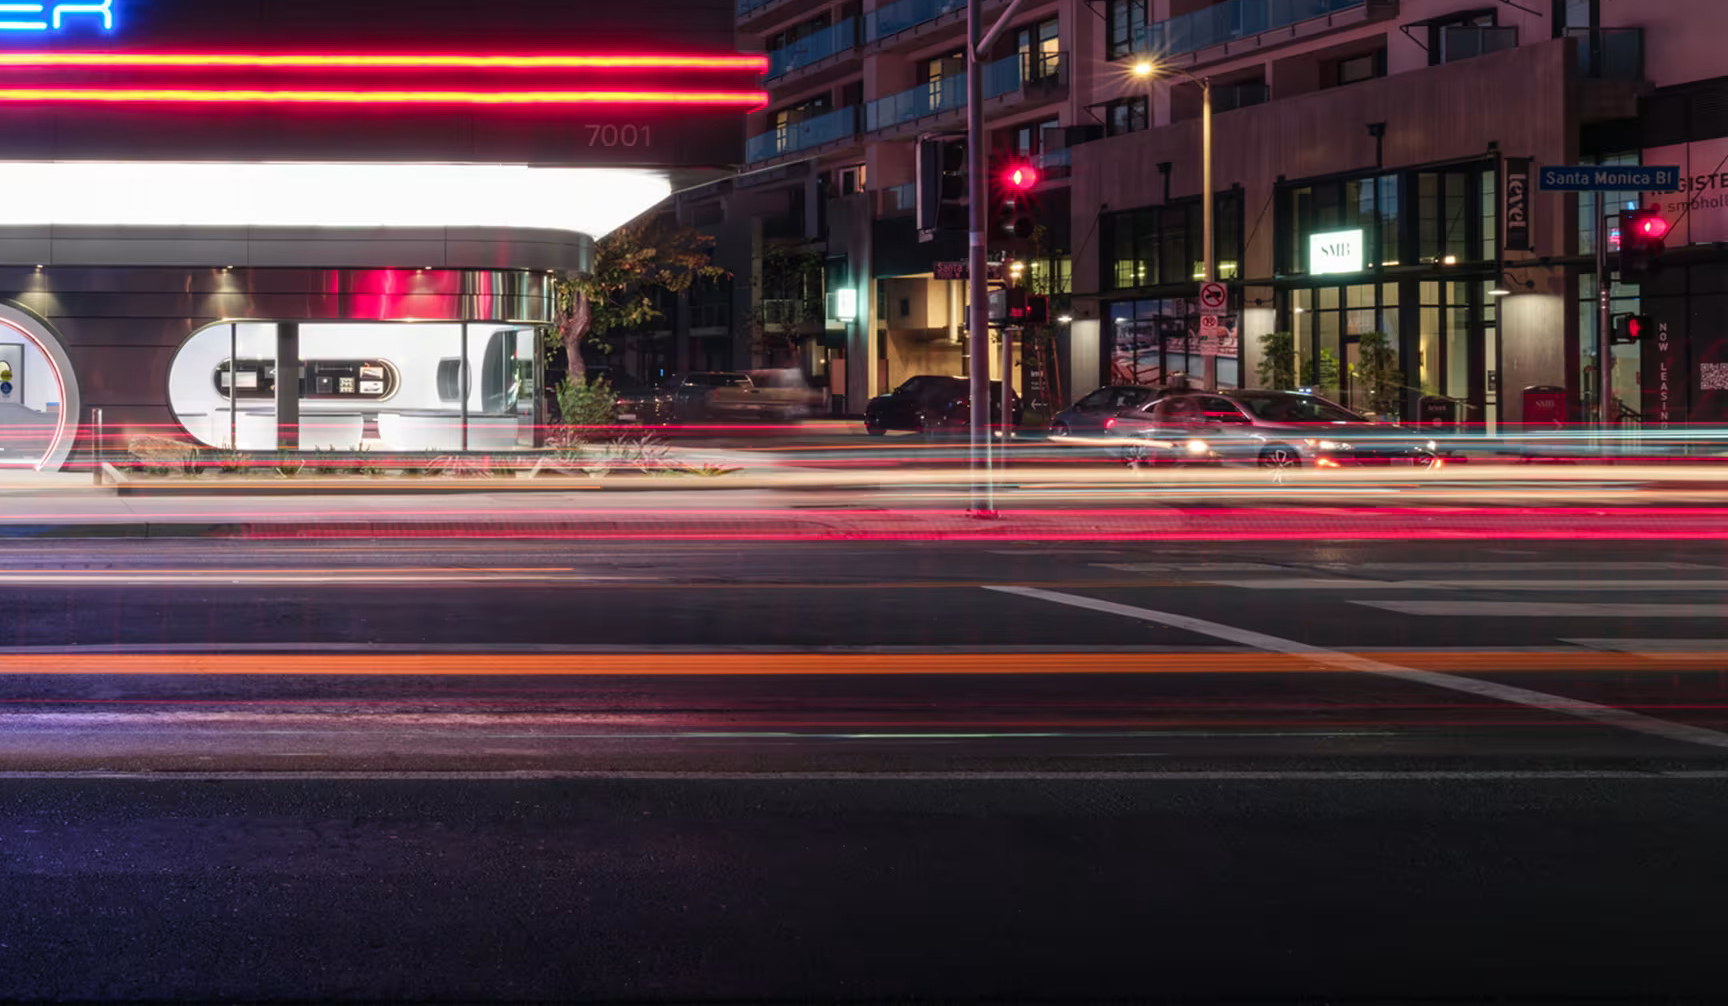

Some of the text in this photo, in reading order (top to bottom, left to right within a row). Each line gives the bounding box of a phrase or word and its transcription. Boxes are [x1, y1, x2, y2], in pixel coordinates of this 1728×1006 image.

[584, 124, 650, 147] 7001
[1545, 171, 1671, 186] Santa Monica Bl
[1651, 173, 1728, 196] GISTE
[1508, 174, 1527, 228] level
[1320, 242, 1351, 257] SMB
[1658, 323, 1669, 352] NOW
